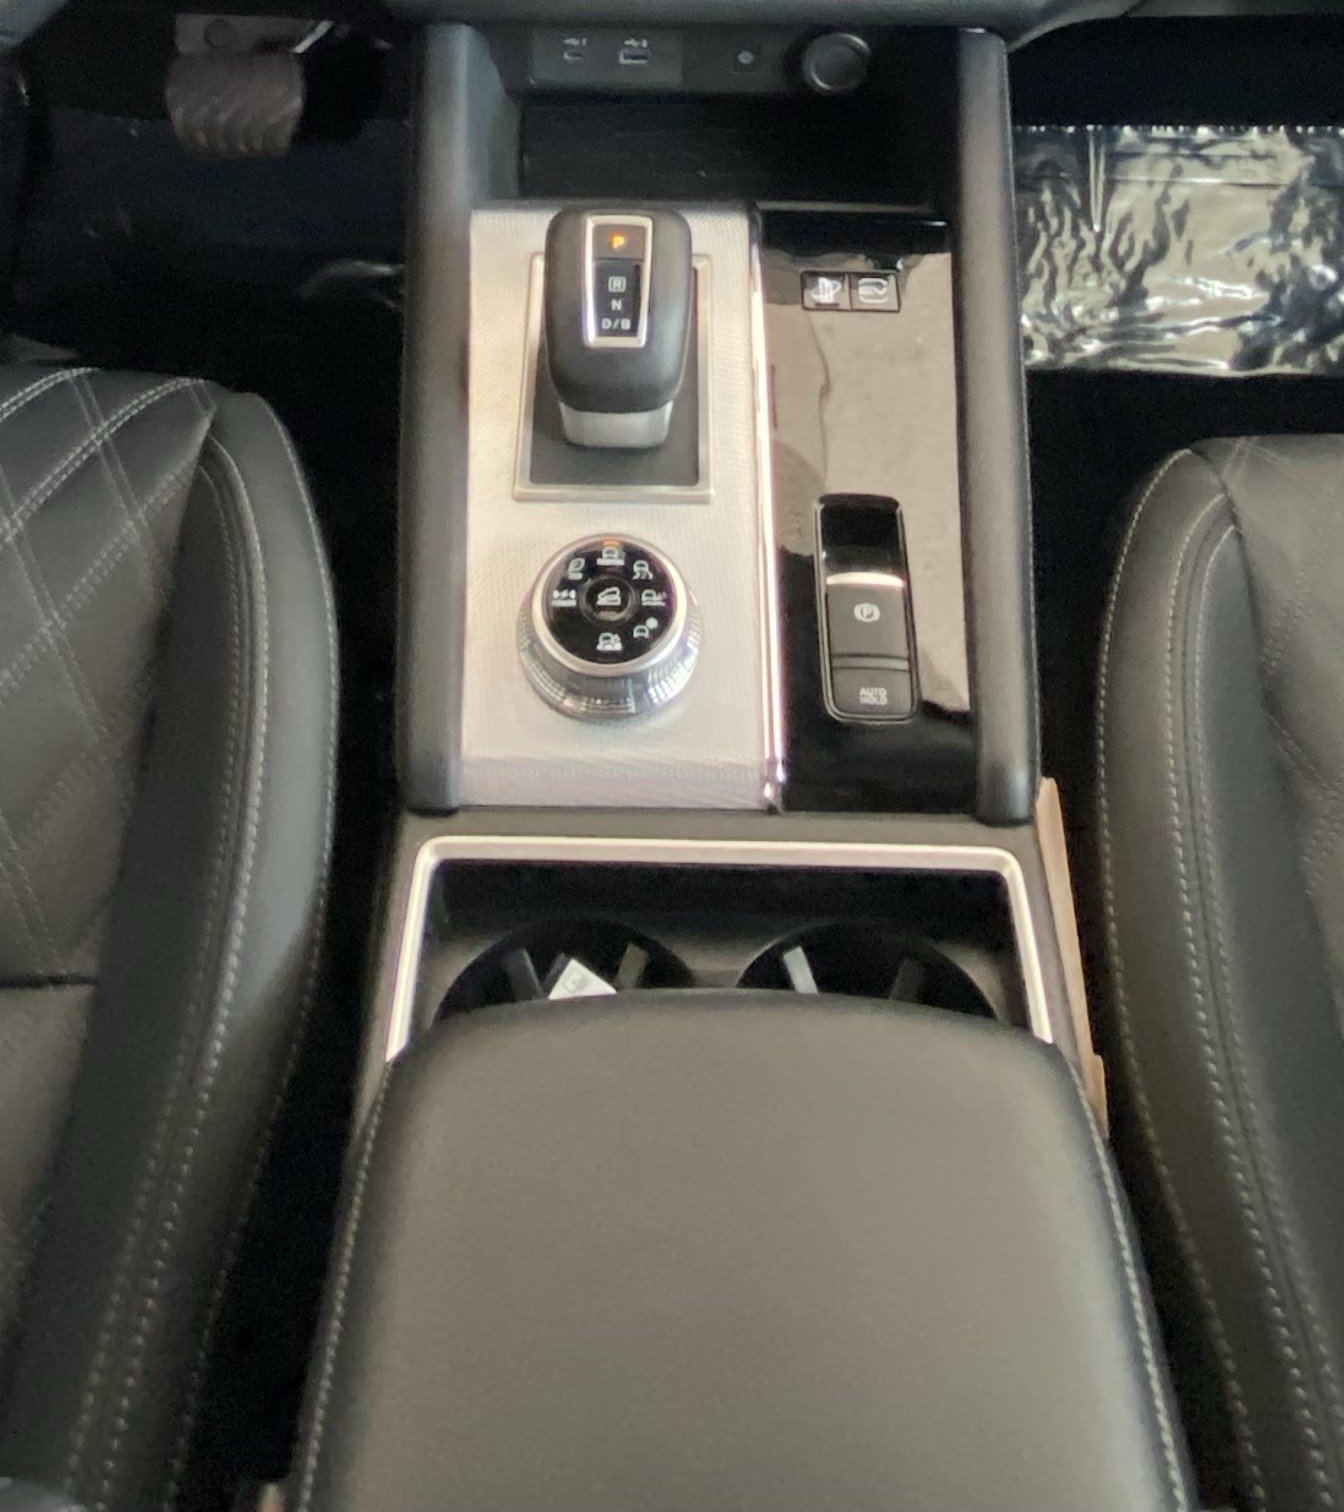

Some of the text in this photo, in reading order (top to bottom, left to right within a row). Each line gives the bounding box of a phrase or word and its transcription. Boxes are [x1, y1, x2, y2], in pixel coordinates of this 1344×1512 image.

[612, 236, 625, 249] P
[611, 299, 622, 311] N
[859, 687, 888, 696] AUTO
[860, 696, 888, 705] HOLD
